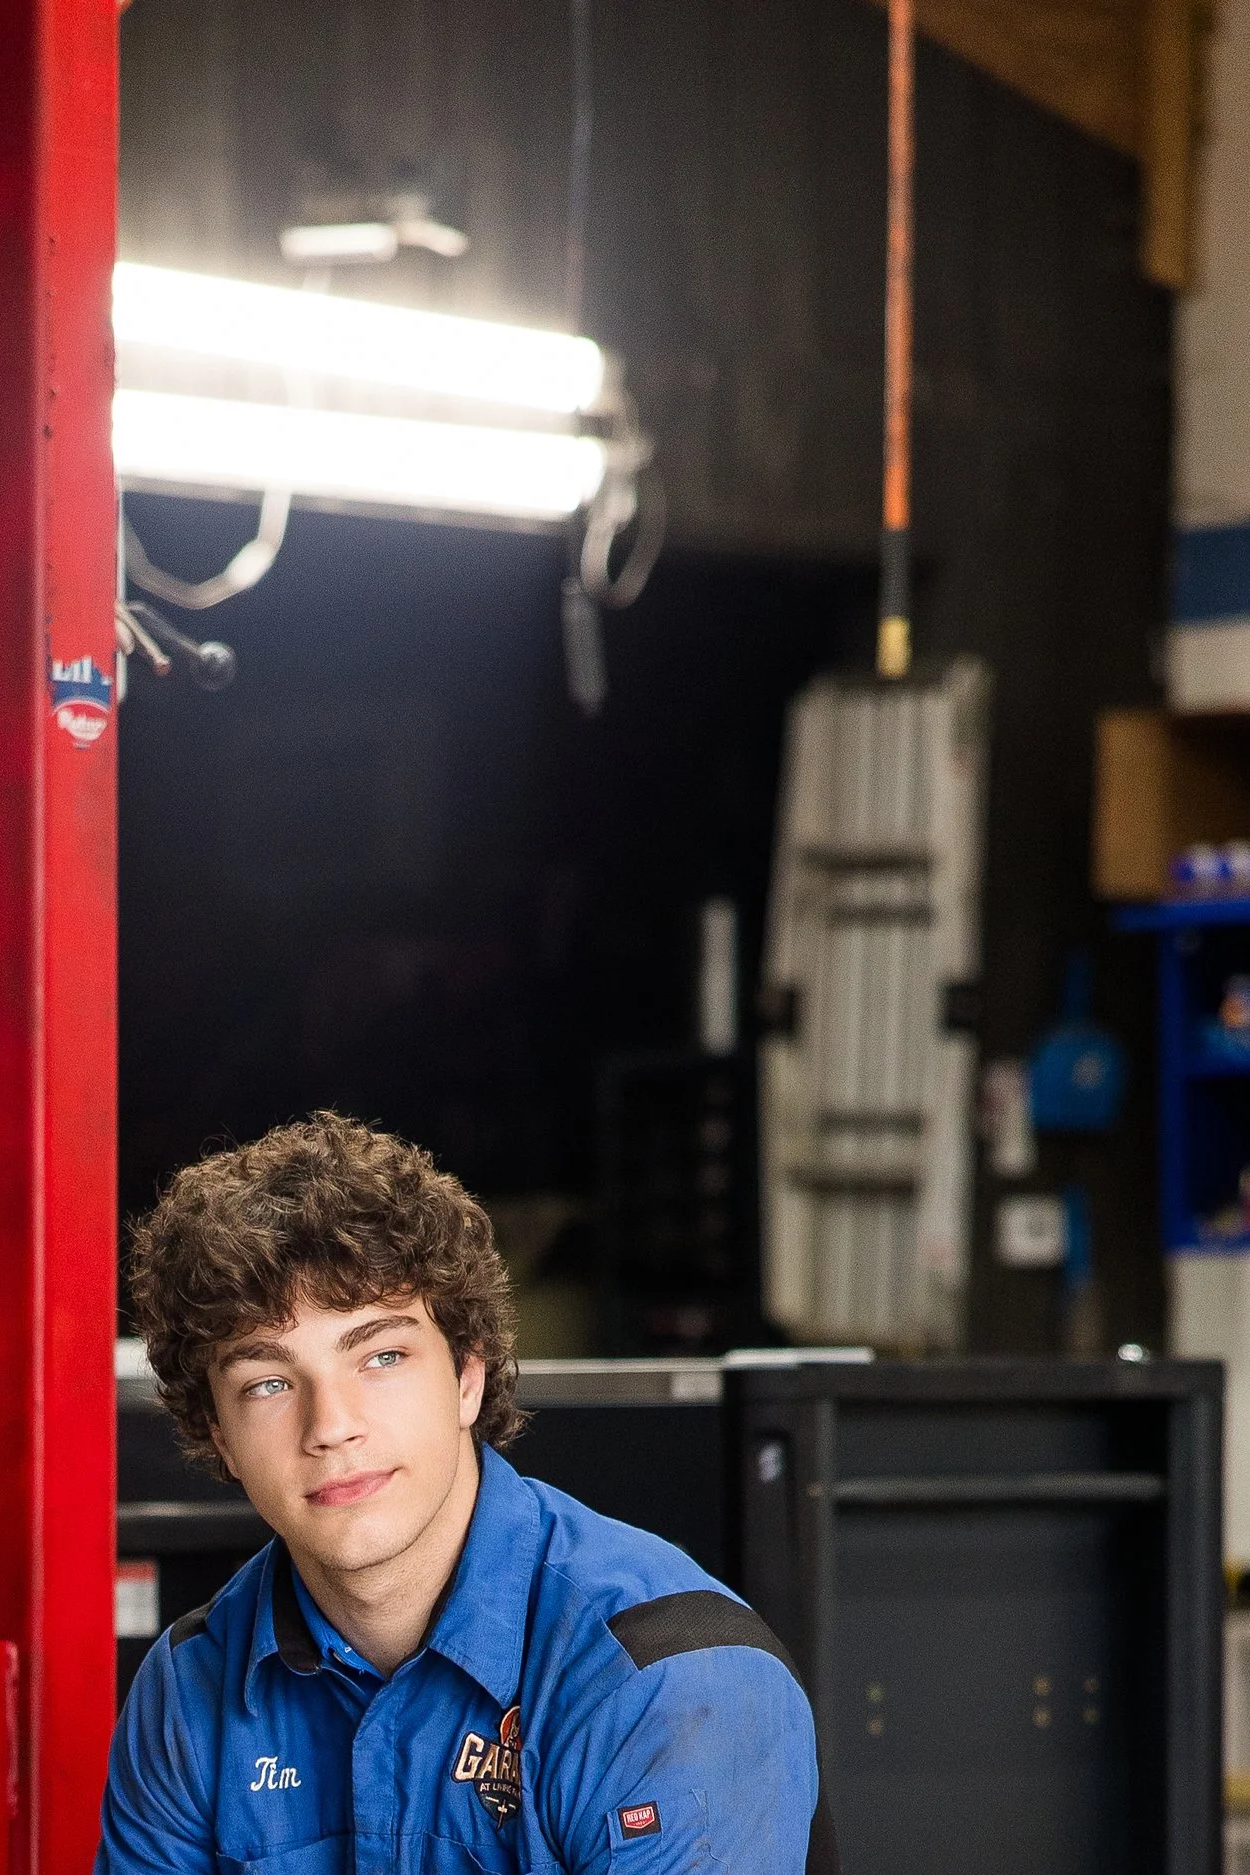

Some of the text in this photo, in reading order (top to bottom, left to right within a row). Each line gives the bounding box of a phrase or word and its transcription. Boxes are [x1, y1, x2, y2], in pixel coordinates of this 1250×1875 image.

[250, 1756, 301, 1792] Tim
[480, 1782, 491, 1792] AT
[626, 1812, 638, 1823] RED
[638, 1809, 651, 1820] KAP
